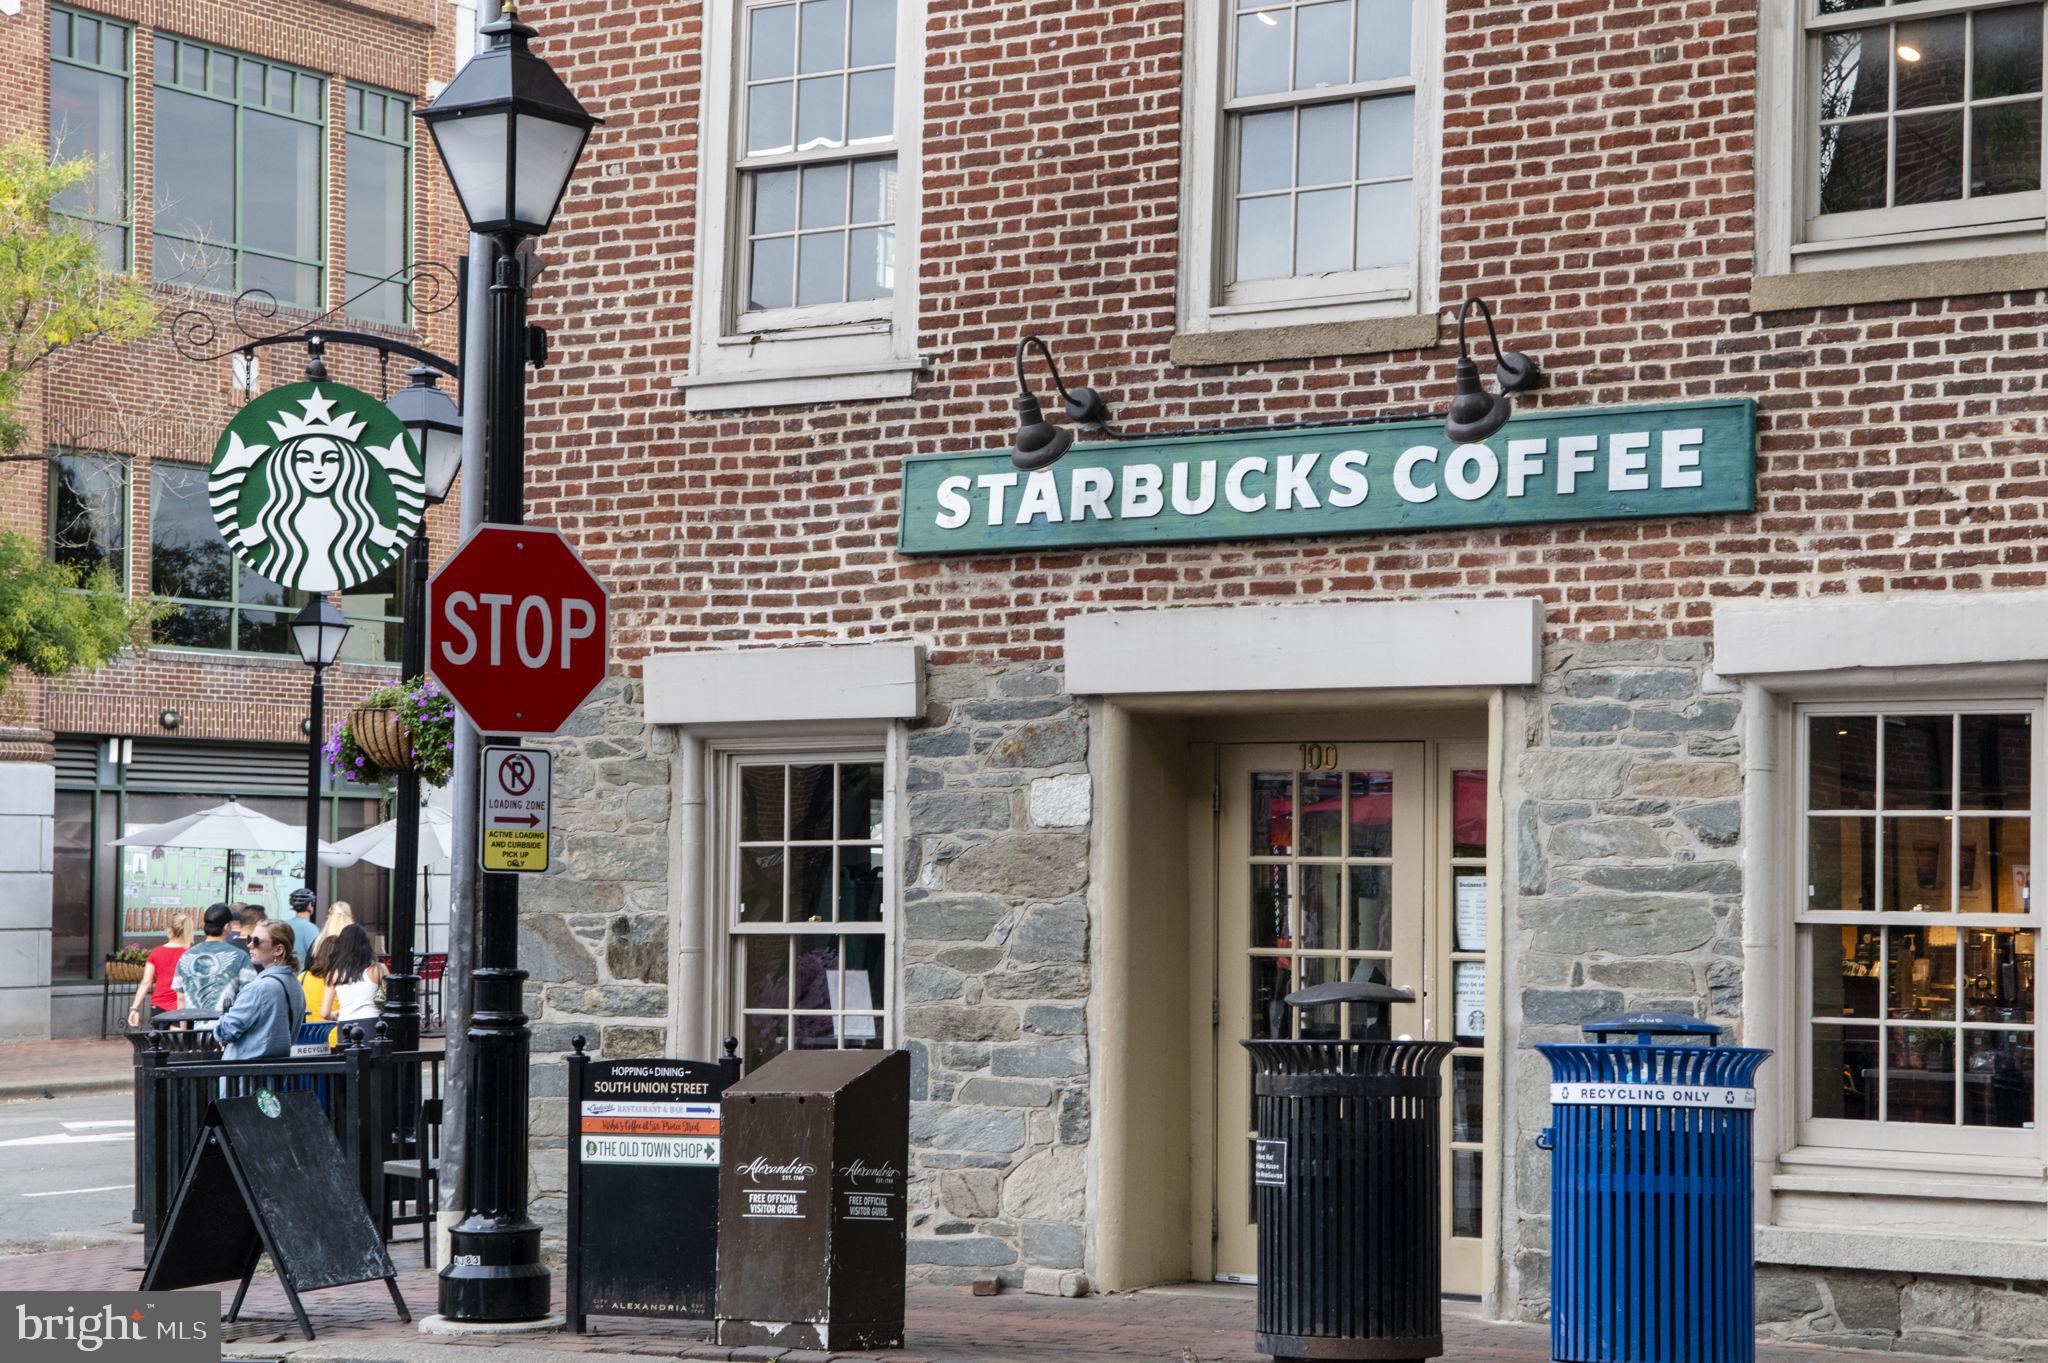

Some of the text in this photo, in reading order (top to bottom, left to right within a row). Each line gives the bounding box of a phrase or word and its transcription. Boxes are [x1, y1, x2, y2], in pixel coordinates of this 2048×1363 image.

[935, 428, 1703, 529] STARBUCKS COFFEE
[441, 590, 597, 670] STOP
[1299, 743, 1338, 771] 100
[489, 799, 546, 811] LOADING ZONE
[488, 831, 545, 840] ACTIVE LOADING
[507, 841, 542, 849] CURBSIDE
[519, 851, 530, 859] UP
[506, 859, 525, 868] OY
[125, 907, 205, 932] ALEXANIA
[611, 1066, 648, 1077] HOPPING
[654, 1067, 684, 1077] DINING
[594, 1081, 709, 1095] SOUTH UNION STREET
[1581, 1088, 1710, 1102] RECYCLING ONLY
[598, 1141, 703, 1158] THE OLD TOWN SHOP
[735, 1156, 817, 1183] Alexandria
[838, 1158, 901, 1186] Alexandria
[749, 1194, 798, 1204] FREE OFFICIAL
[848, 1196, 888, 1207] FREE OFFICIAL
[750, 1204, 798, 1214] VISITOR GUIDE
[849, 1207, 889, 1217] VISITOR GUIDE
[611, 1302, 688, 1312] ALEXANDRIA
